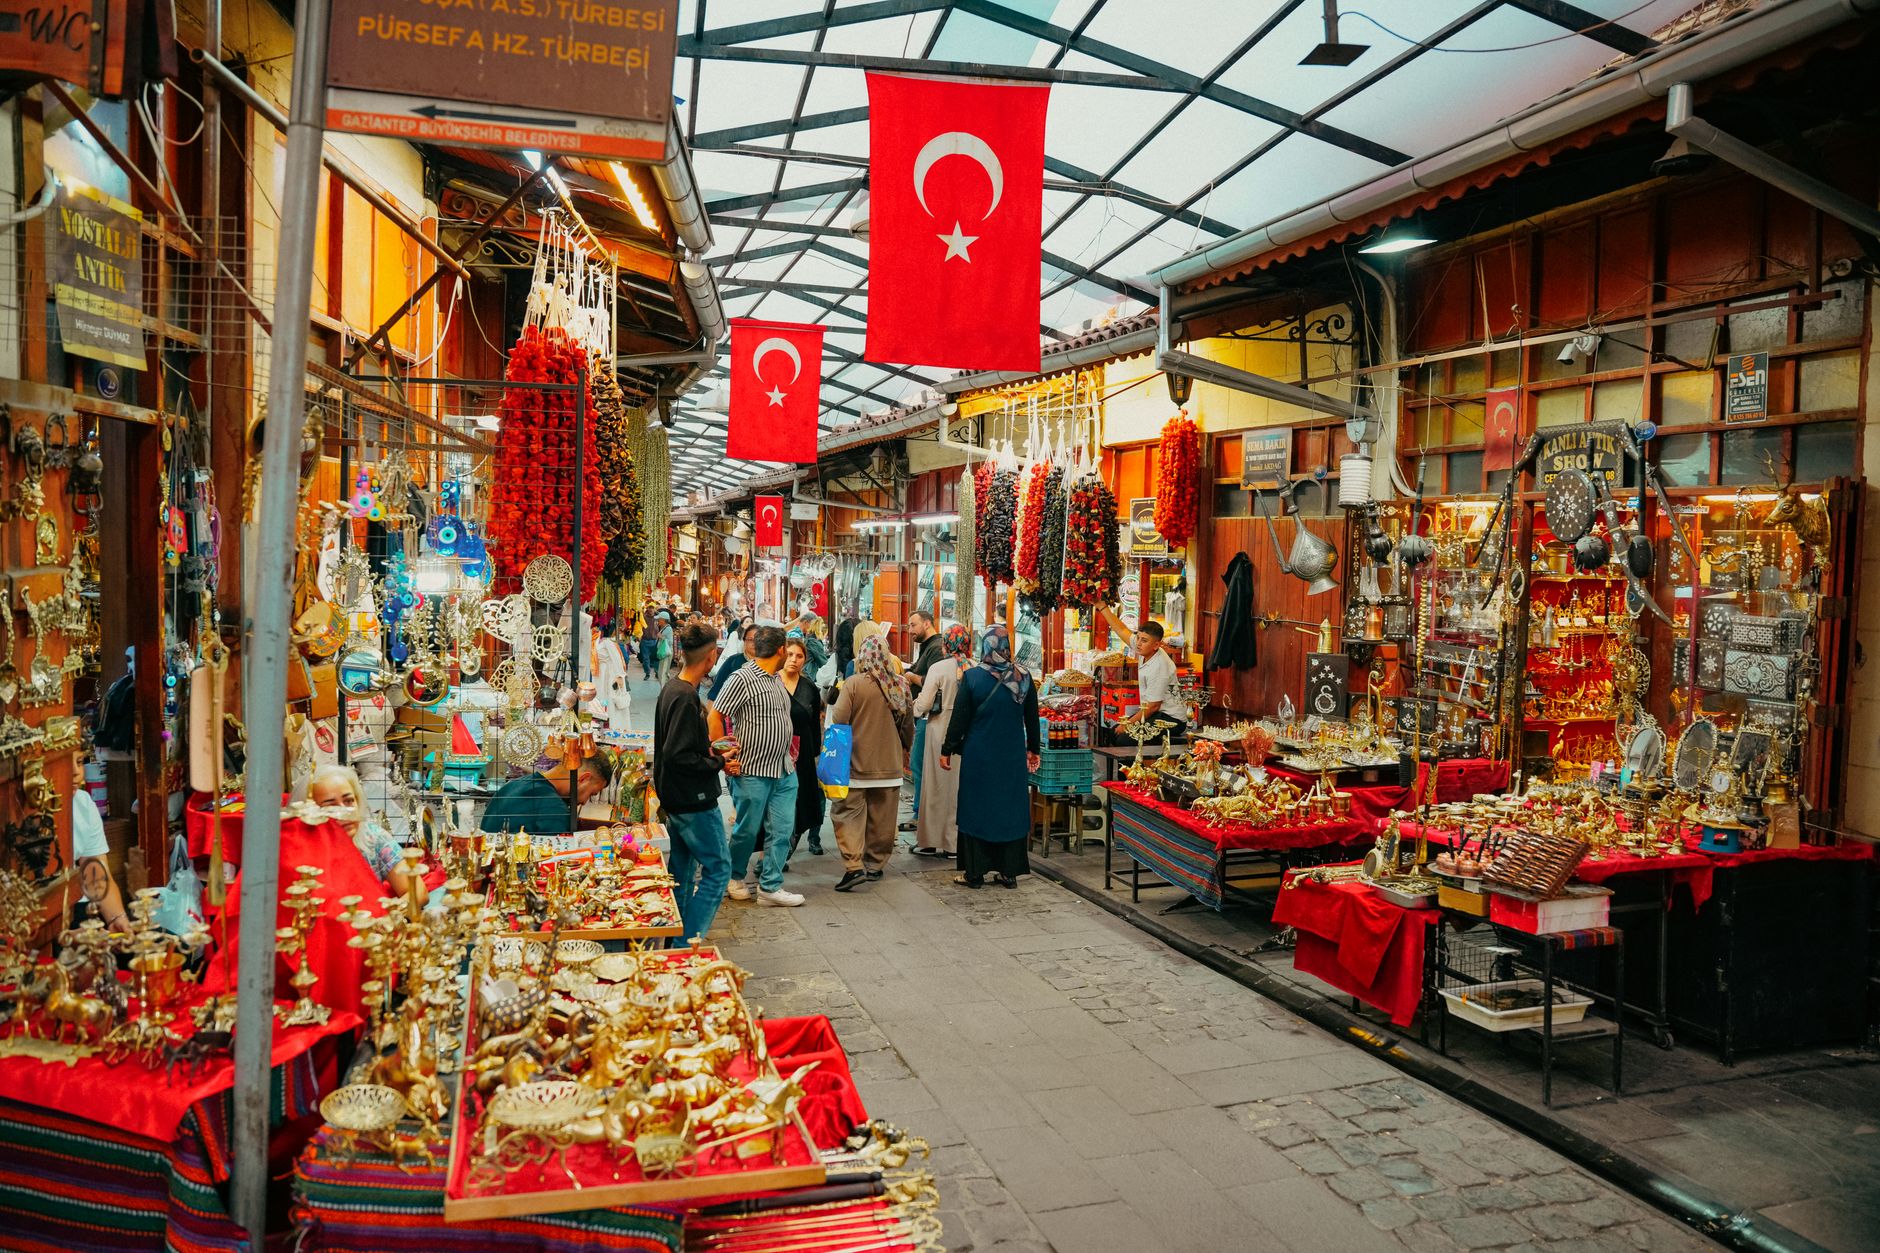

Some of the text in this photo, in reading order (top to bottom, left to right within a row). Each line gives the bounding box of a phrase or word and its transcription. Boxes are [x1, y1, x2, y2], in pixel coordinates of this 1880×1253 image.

[24, 5, 90, 51] WC
[557, 0, 666, 32] TÜRBESİ
[493, 32, 535, 57] HZ.
[541, 36, 650, 69] TÜRBESİ
[341, 114, 582, 150] GAZİANTEP BÜYÜKŞEHİR BELEDİYESİ
[74, 252, 128, 294] ANTİK
[1543, 432, 1577, 460] KANLI
